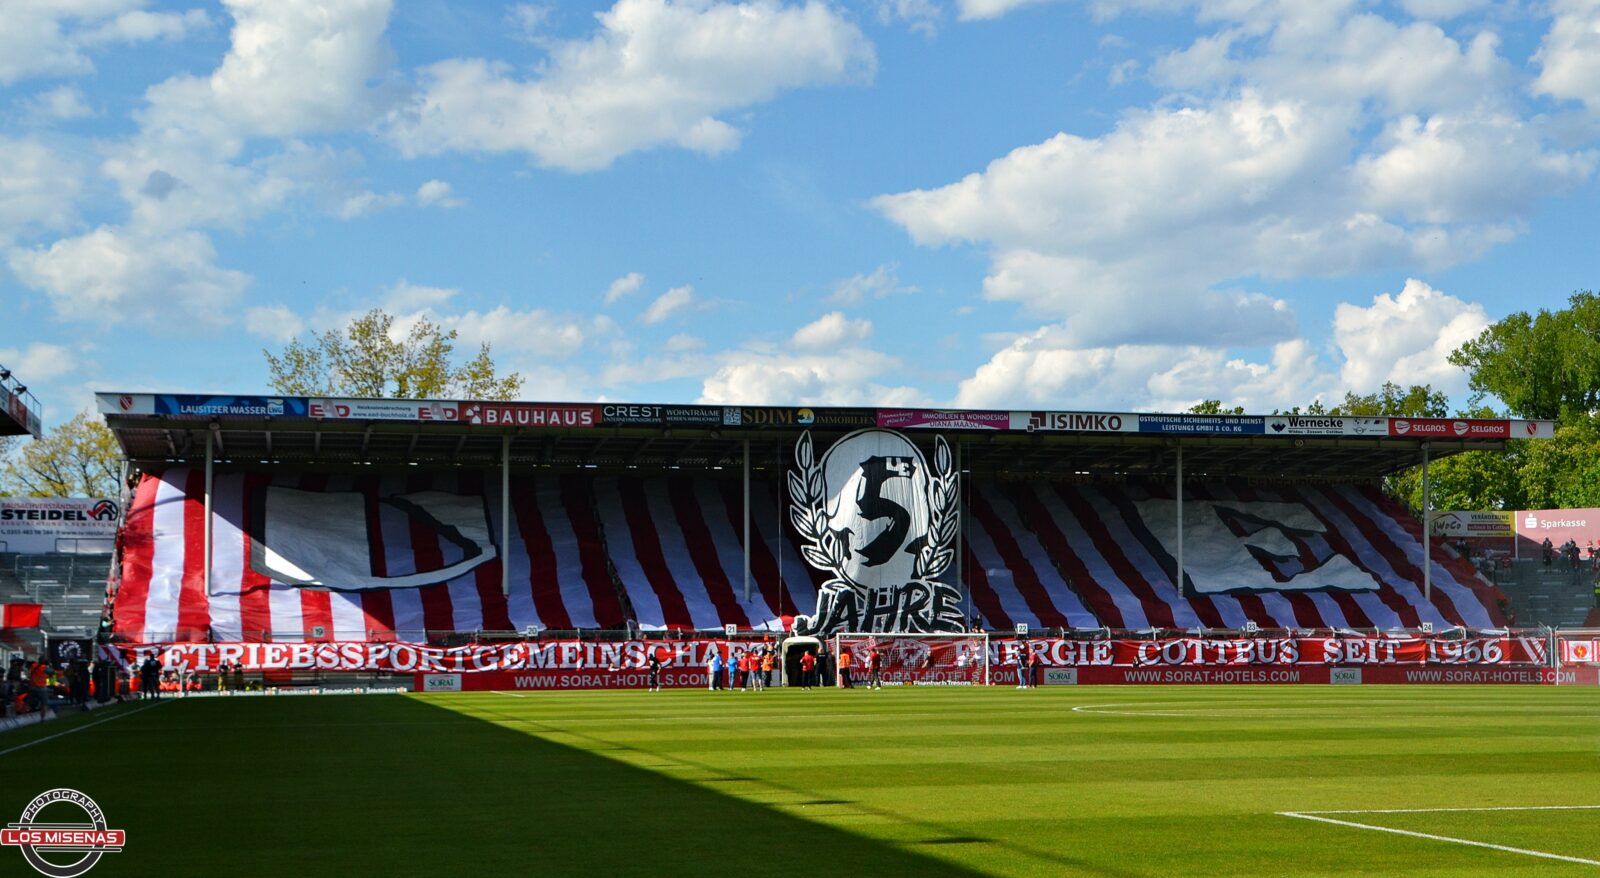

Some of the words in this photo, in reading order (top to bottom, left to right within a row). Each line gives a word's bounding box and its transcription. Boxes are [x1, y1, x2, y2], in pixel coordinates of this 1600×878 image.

[180, 405, 230, 414] LAUSITZER
[230, 406, 266, 415] WASSER
[310, 400, 350, 418] EAD
[418, 402, 458, 420] EAD
[604, 406, 662, 418] CREST
[486, 409, 592, 425] BAUHAUS
[742, 408, 794, 424] SDIM
[1051, 414, 1122, 431] ISIMKO
[1288, 416, 1344, 428] Wernecke
[1412, 424, 1446, 432] SELGROS
[1, 510, 88, 521] STEIDEL
[854, 454, 917, 568] 5
[1540, 518, 1586, 528] Sparkasse
[792, 577, 966, 636] JAHRE
[314, 628, 324, 636] 19
[528, 626, 538, 635] 20
[727, 626, 736, 634] 21
[1018, 624, 1027, 632] 22
[1248, 624, 1256, 632] 23
[1424, 624, 1432, 632] 24
[1138, 638, 1300, 666] COTTBUS
[1322, 637, 1400, 664] SEIT
[1426, 637, 1504, 664] 1966
[1048, 672, 1072, 680] SORAT
[1124, 670, 1300, 683] WWW.SORAT-HOTELS.COM
[1334, 672, 1356, 680] SORAT
[1406, 670, 1576, 683] WWW.SORAT-HOTELS.COM
[428, 678, 455, 687] SORAT
